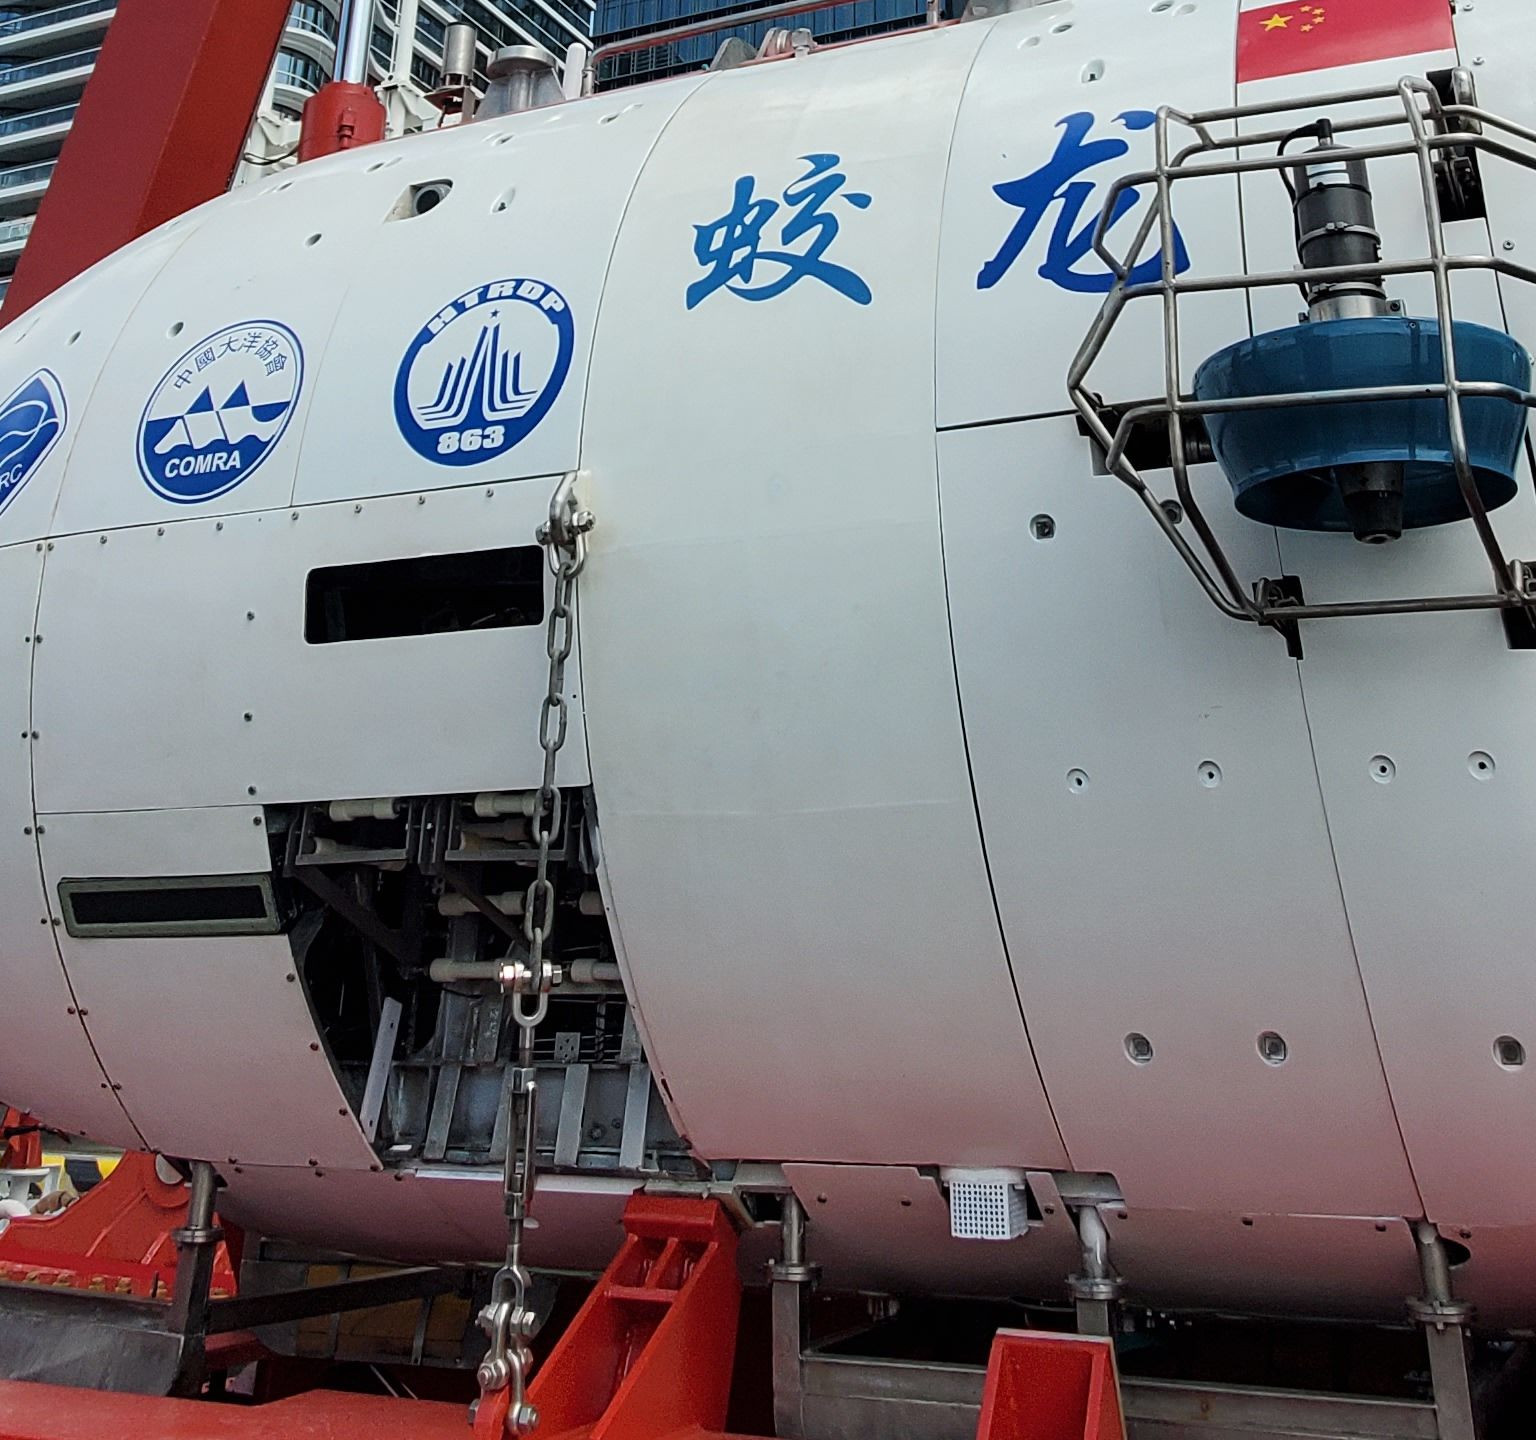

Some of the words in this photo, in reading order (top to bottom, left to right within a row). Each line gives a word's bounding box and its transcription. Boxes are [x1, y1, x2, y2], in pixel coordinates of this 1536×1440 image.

[686, 110, 1191, 310] 蛟龙
[426, 279, 565, 335] HTRDP
[174, 332, 288, 389] 中國大洋協會
[165, 450, 241, 478] COMRA
[437, 425, 505, 454] 863
